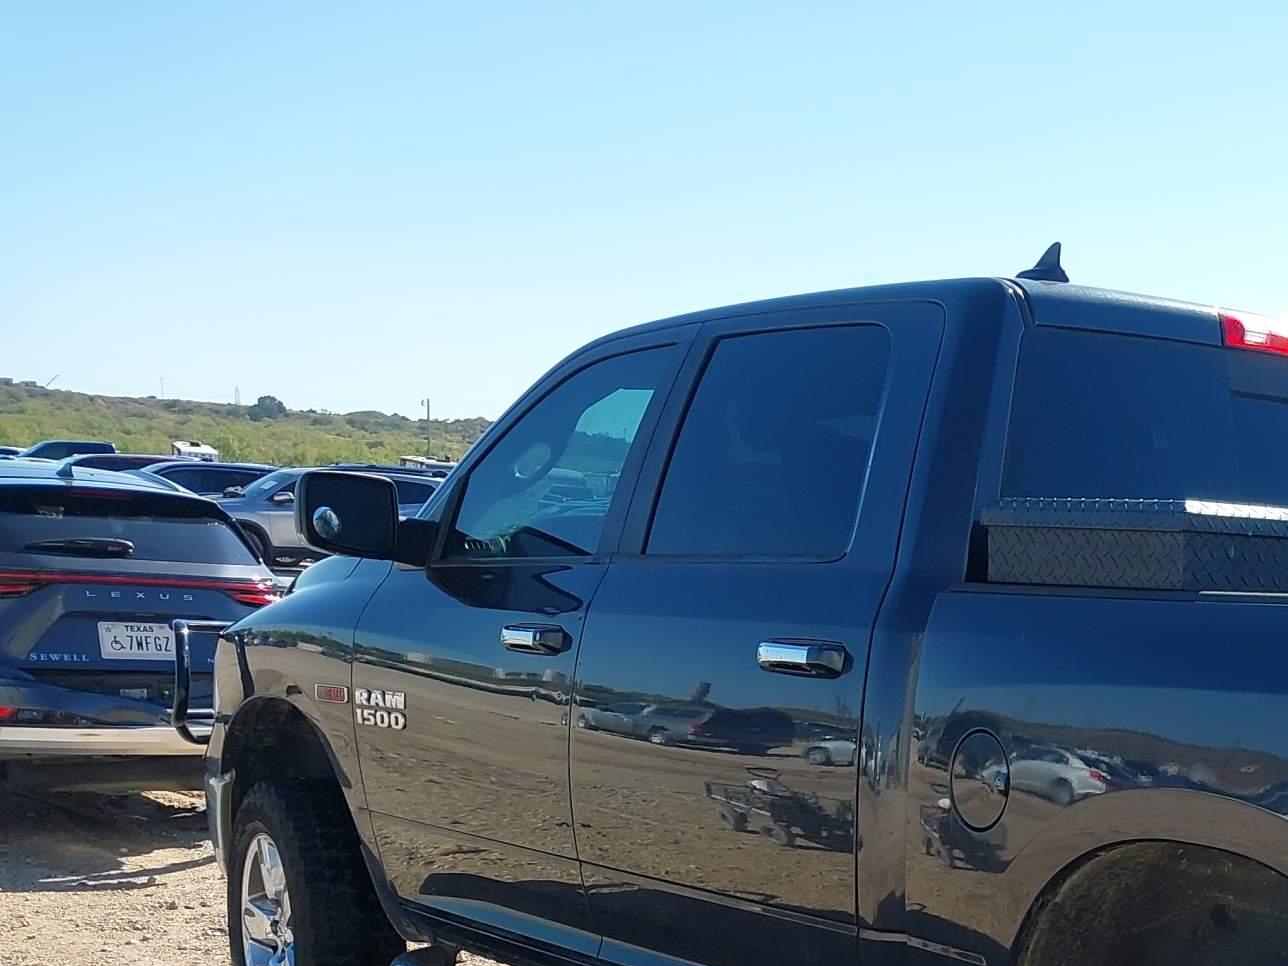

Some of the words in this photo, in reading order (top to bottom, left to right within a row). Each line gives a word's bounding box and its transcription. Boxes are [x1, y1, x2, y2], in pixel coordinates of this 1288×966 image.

[85, 590, 194, 602] LEXUS
[124, 624, 155, 634] TEXAS
[30, 652, 90, 662] SEWELL
[355, 688, 406, 710] RAM
[355, 708, 407, 731] 1500
